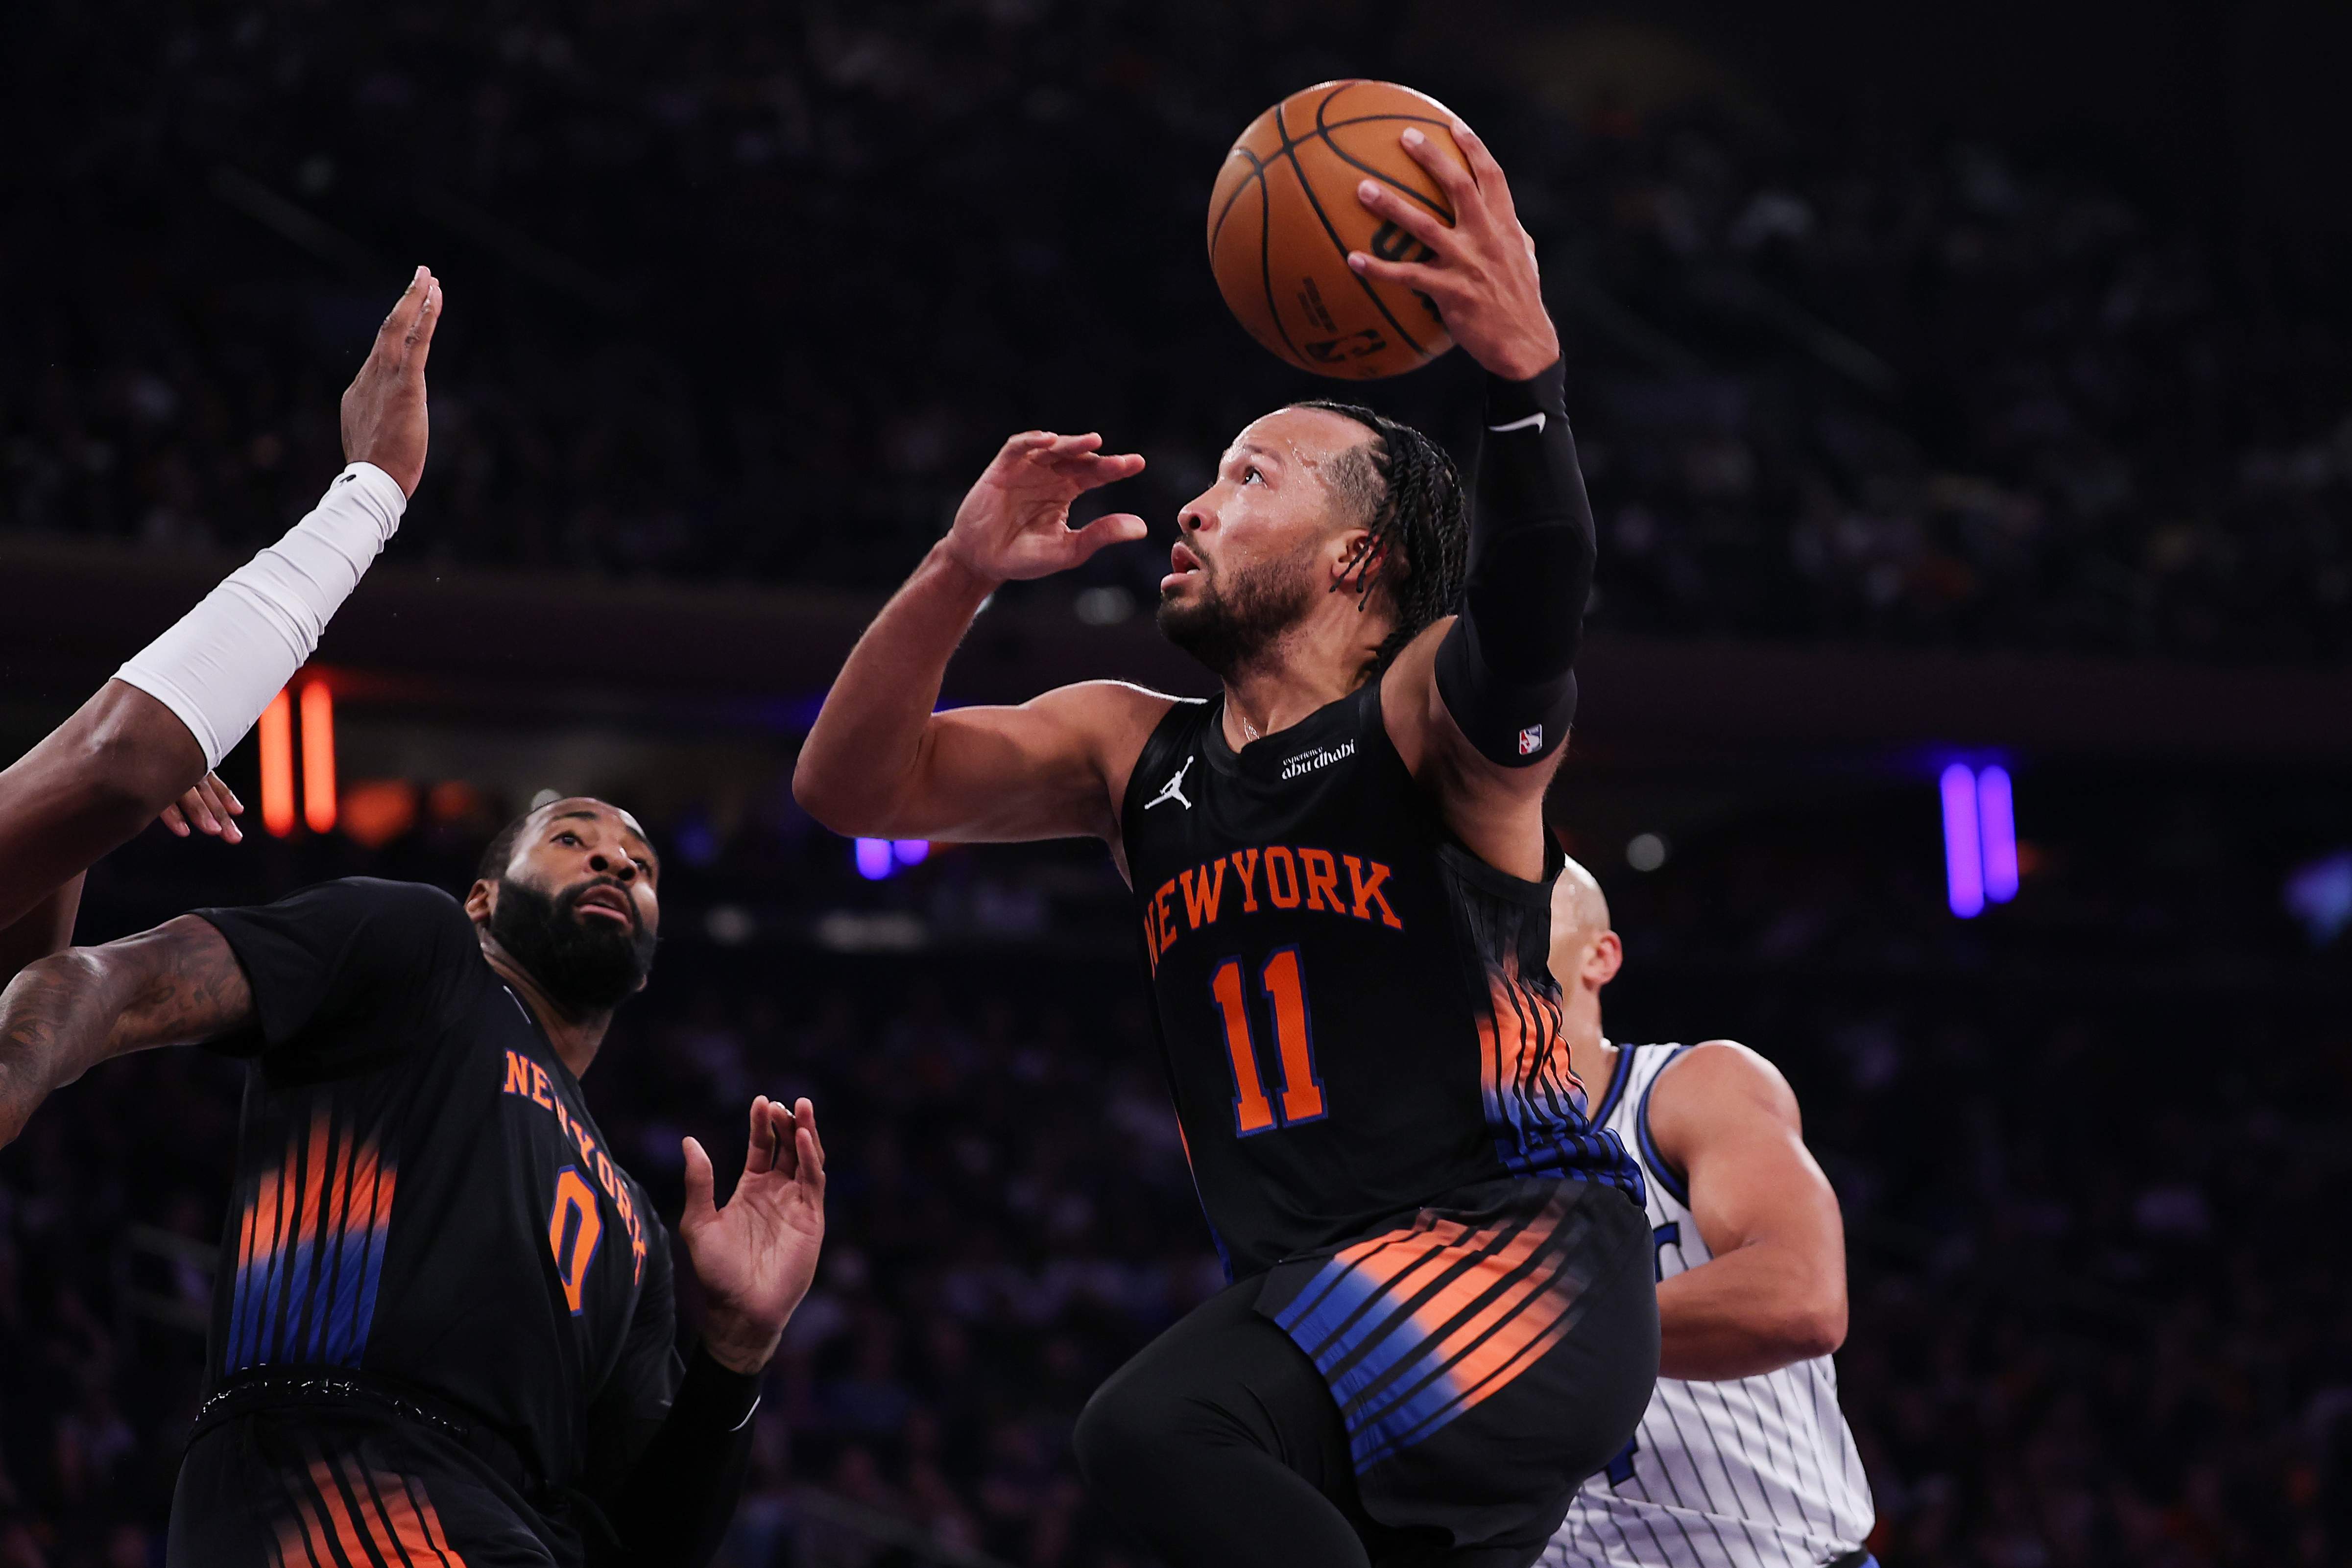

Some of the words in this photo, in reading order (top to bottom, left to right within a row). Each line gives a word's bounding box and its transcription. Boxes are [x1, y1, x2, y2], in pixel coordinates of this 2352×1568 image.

[1281, 760, 1312, 780] abu
[1314, 738, 1355, 769] dhabi
[1208, 943, 1329, 1139] 11
[549, 1164, 603, 1317] 0
